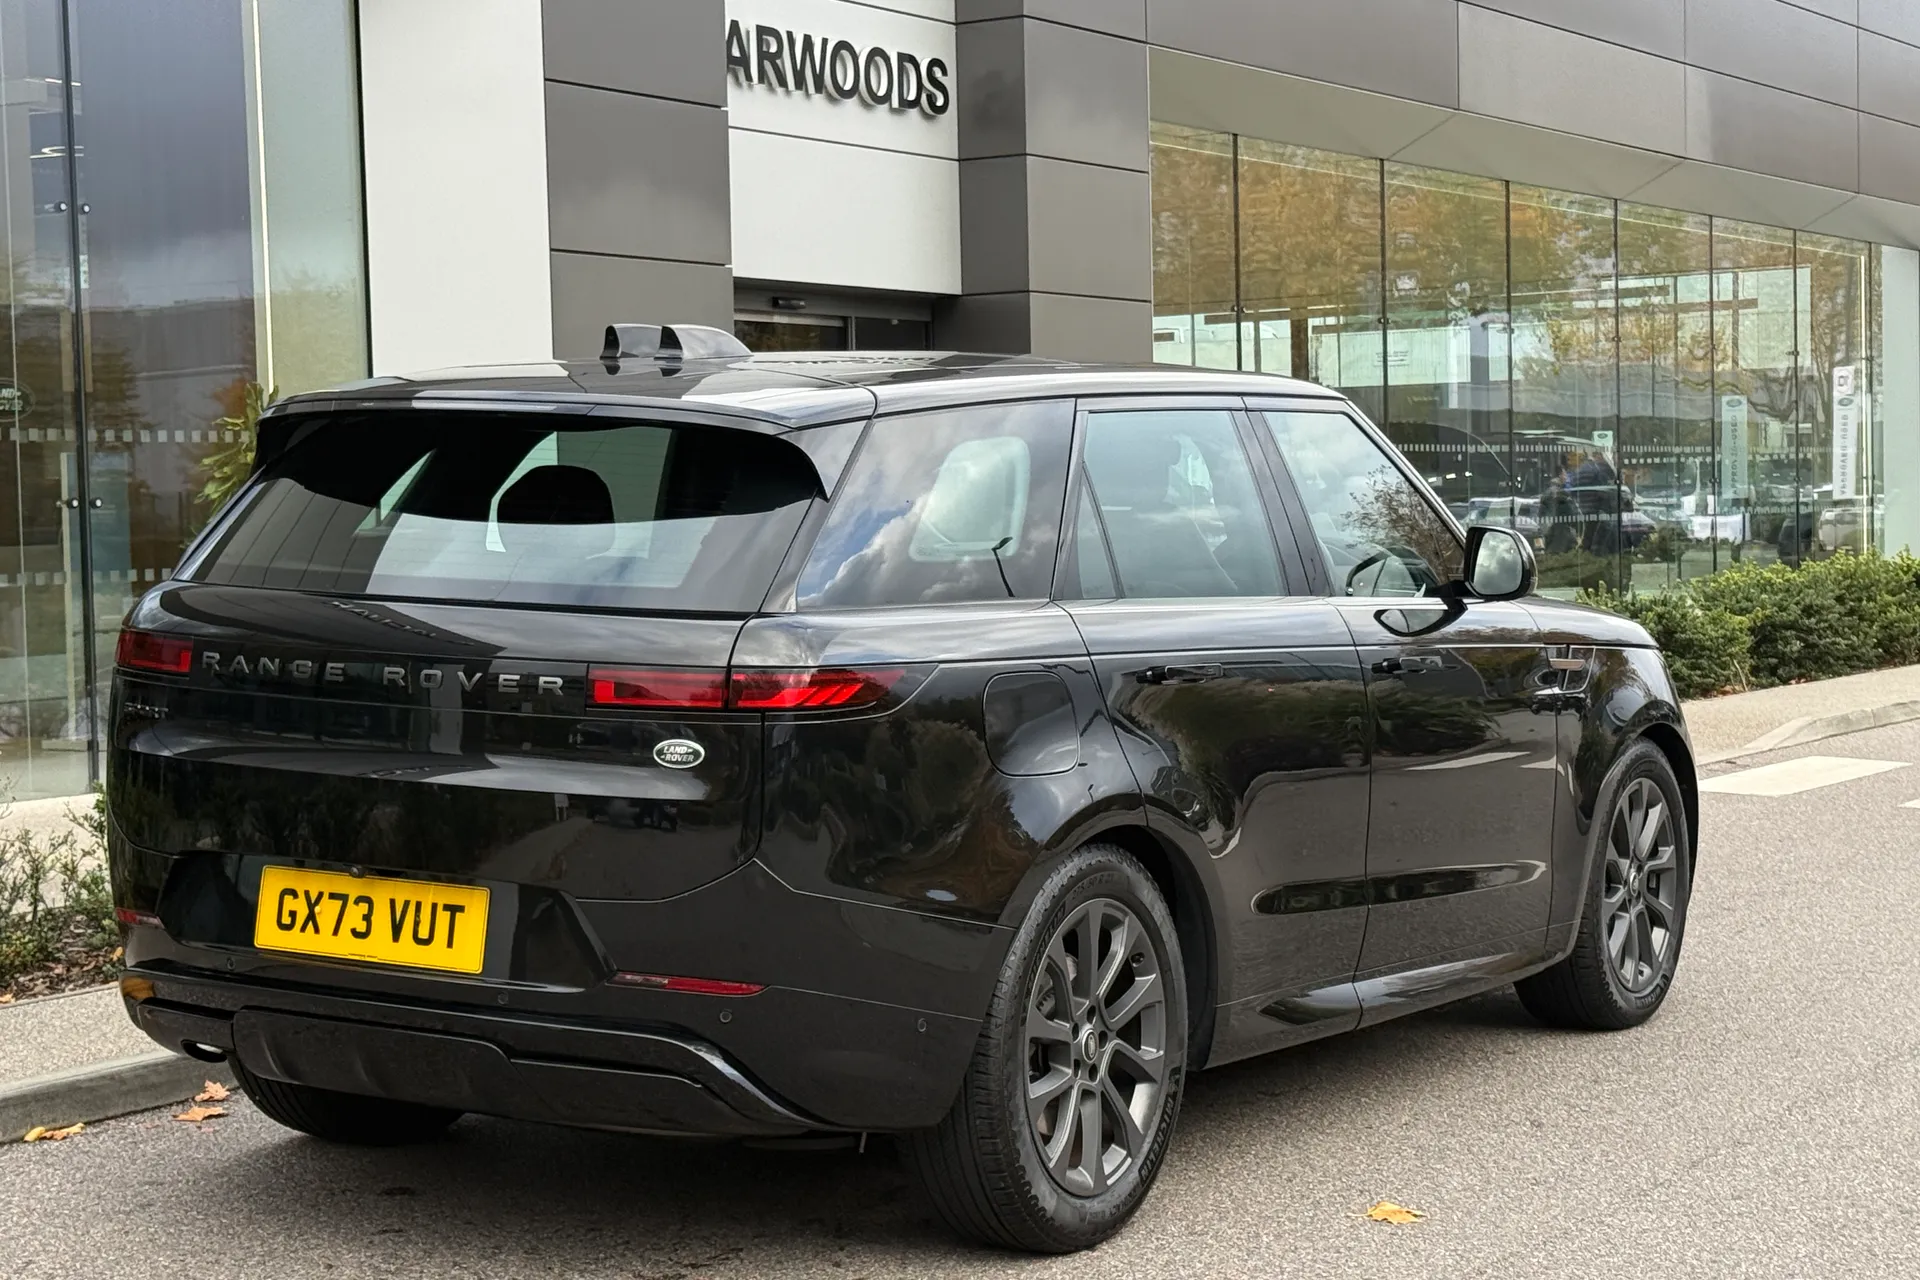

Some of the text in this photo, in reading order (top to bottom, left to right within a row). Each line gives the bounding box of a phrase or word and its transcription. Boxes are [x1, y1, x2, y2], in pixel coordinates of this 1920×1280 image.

[726, 19, 949, 116] ARWOODS
[201, 651, 563, 696] RANGE ROVER
[276, 887, 466, 949] GX73 VUT
